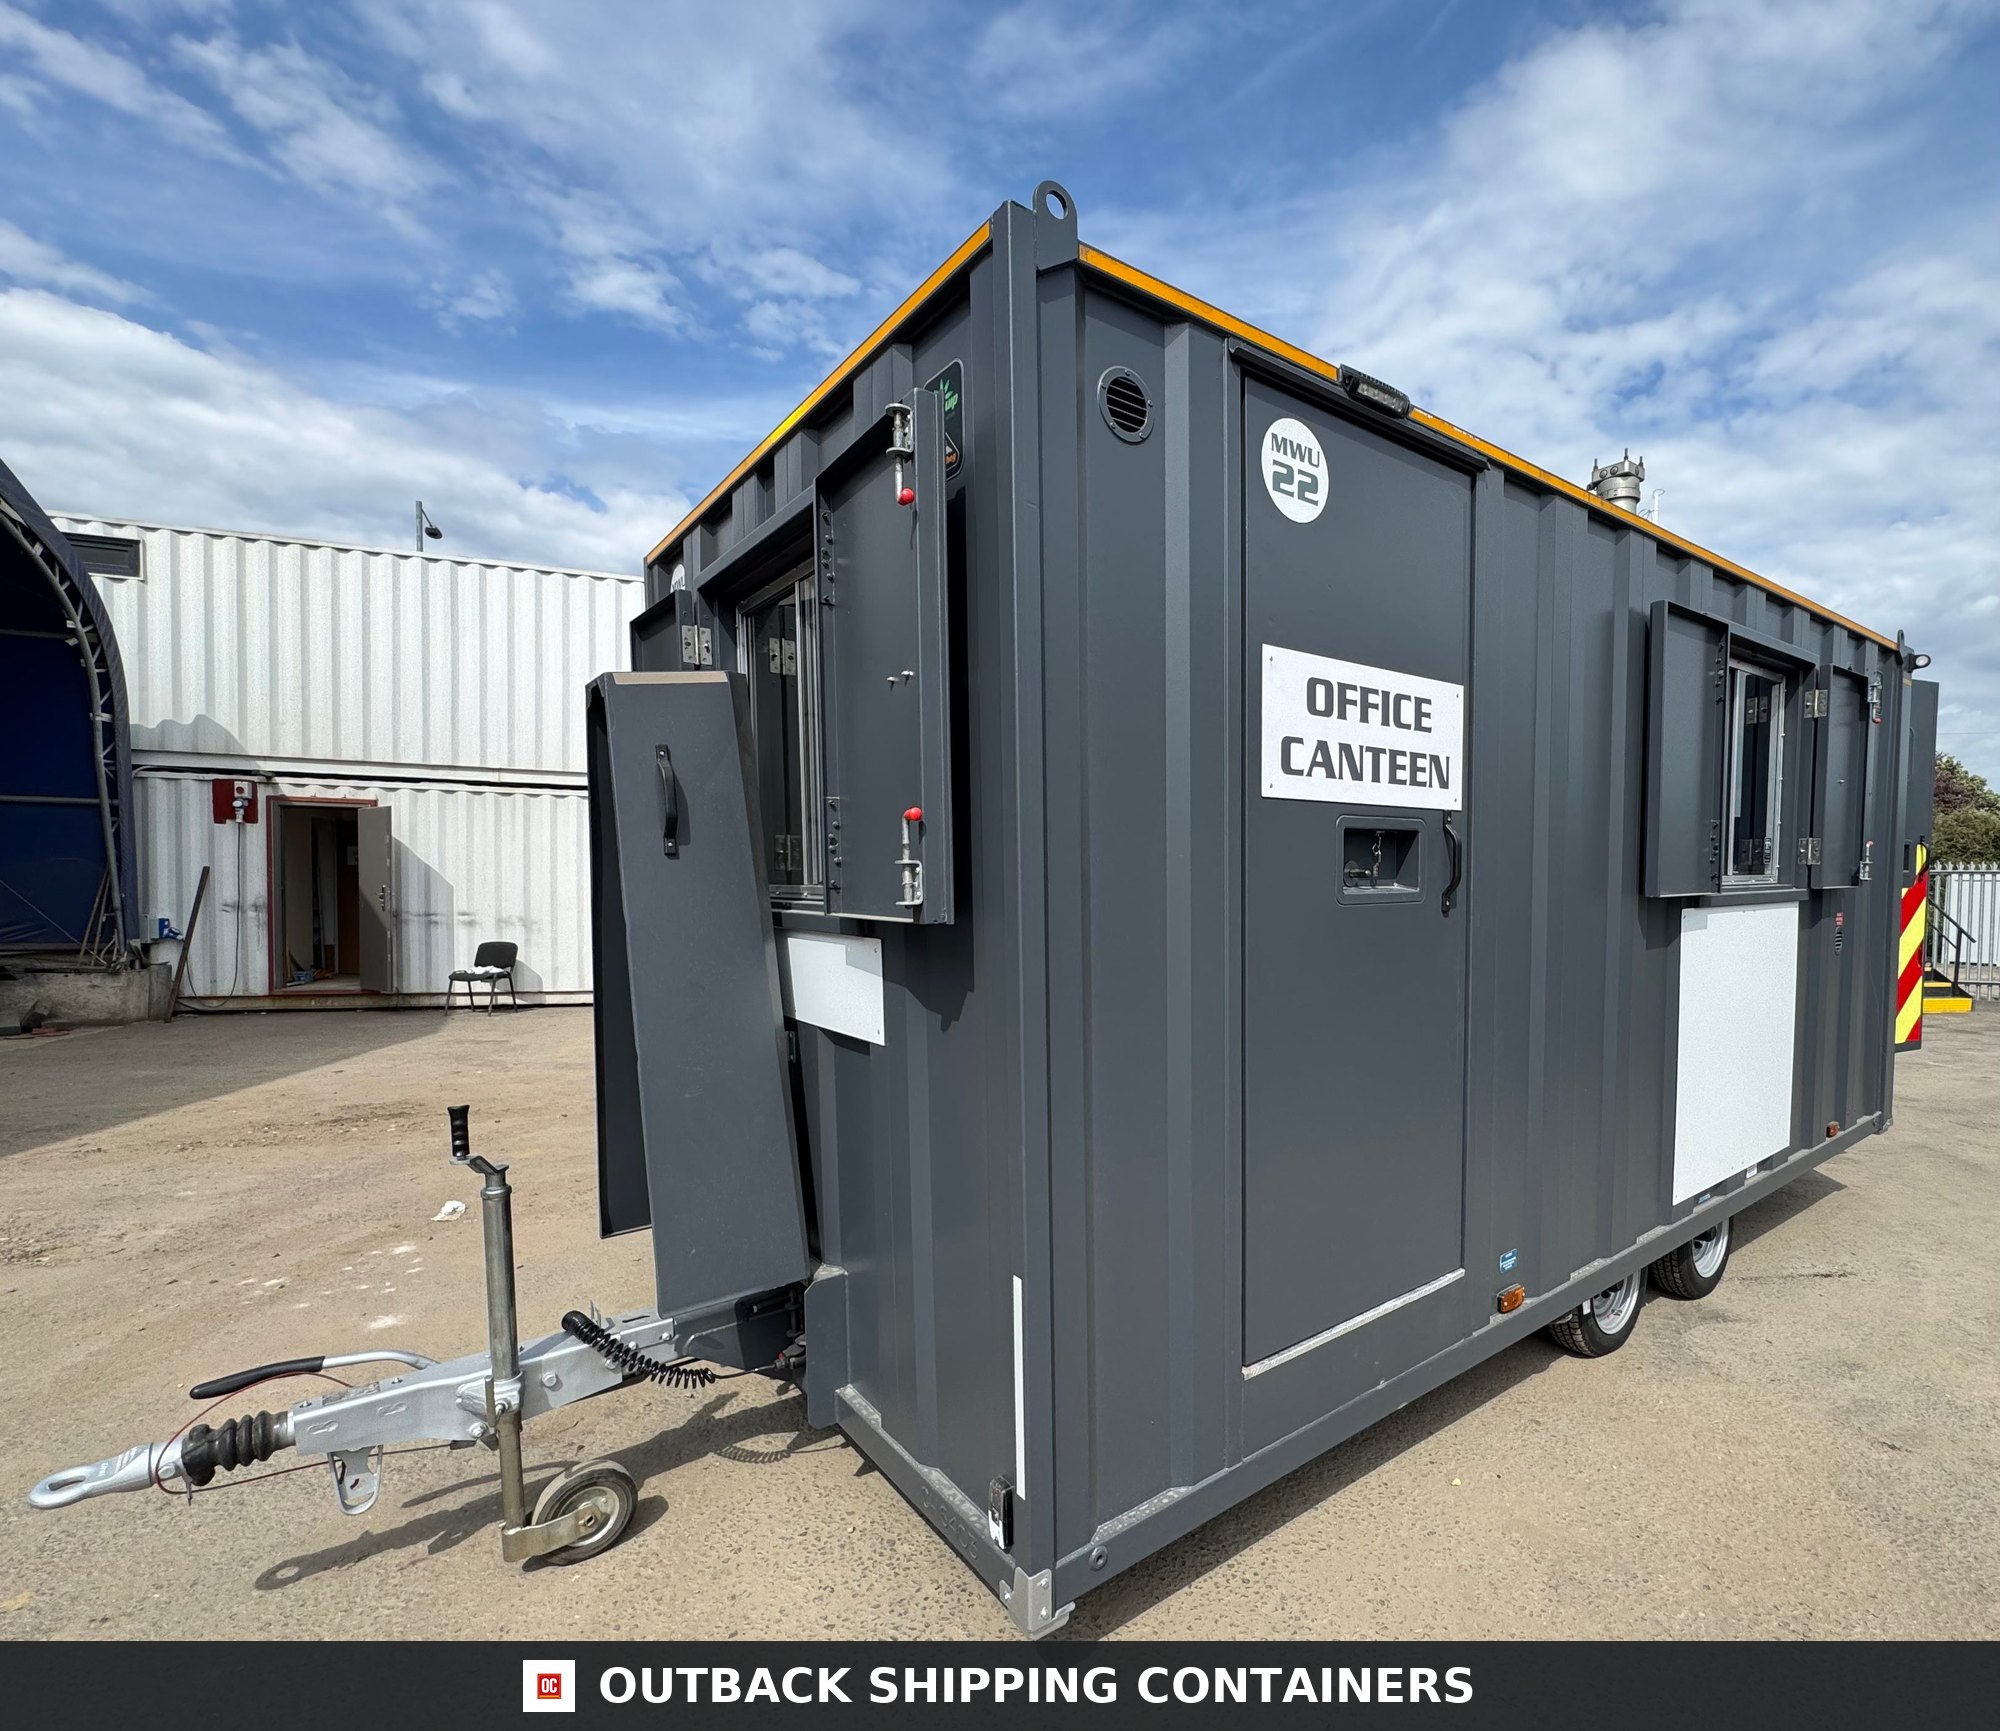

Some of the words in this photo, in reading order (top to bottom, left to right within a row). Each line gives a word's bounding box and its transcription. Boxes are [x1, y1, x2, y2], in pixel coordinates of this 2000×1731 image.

[1271, 432, 1320, 468] MWU
[1272, 459, 1319, 507] 22
[1306, 676, 1433, 733] OFFICE
[1280, 735, 1451, 790] CANTEEN
